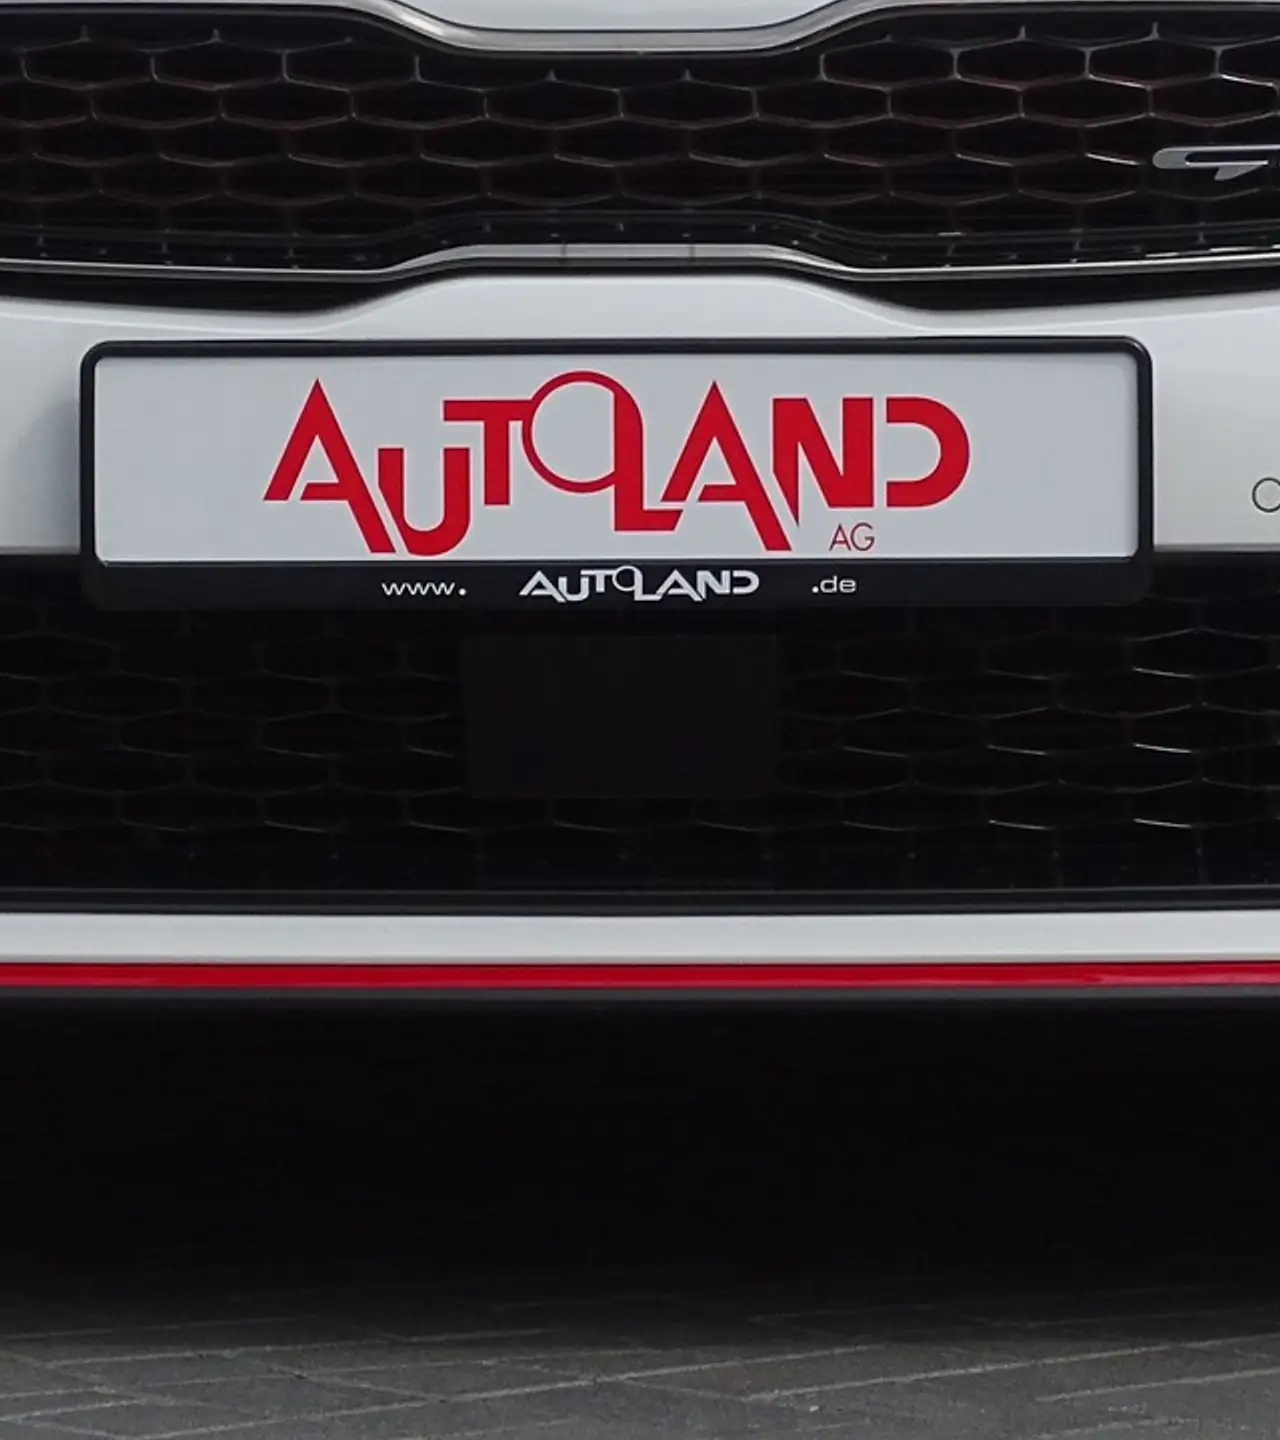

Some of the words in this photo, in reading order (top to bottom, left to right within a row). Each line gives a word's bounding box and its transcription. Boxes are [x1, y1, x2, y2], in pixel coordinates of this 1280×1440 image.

[829, 523, 876, 552] AG
[381, 581, 467, 596] www.
[812, 575, 857, 594] .de
